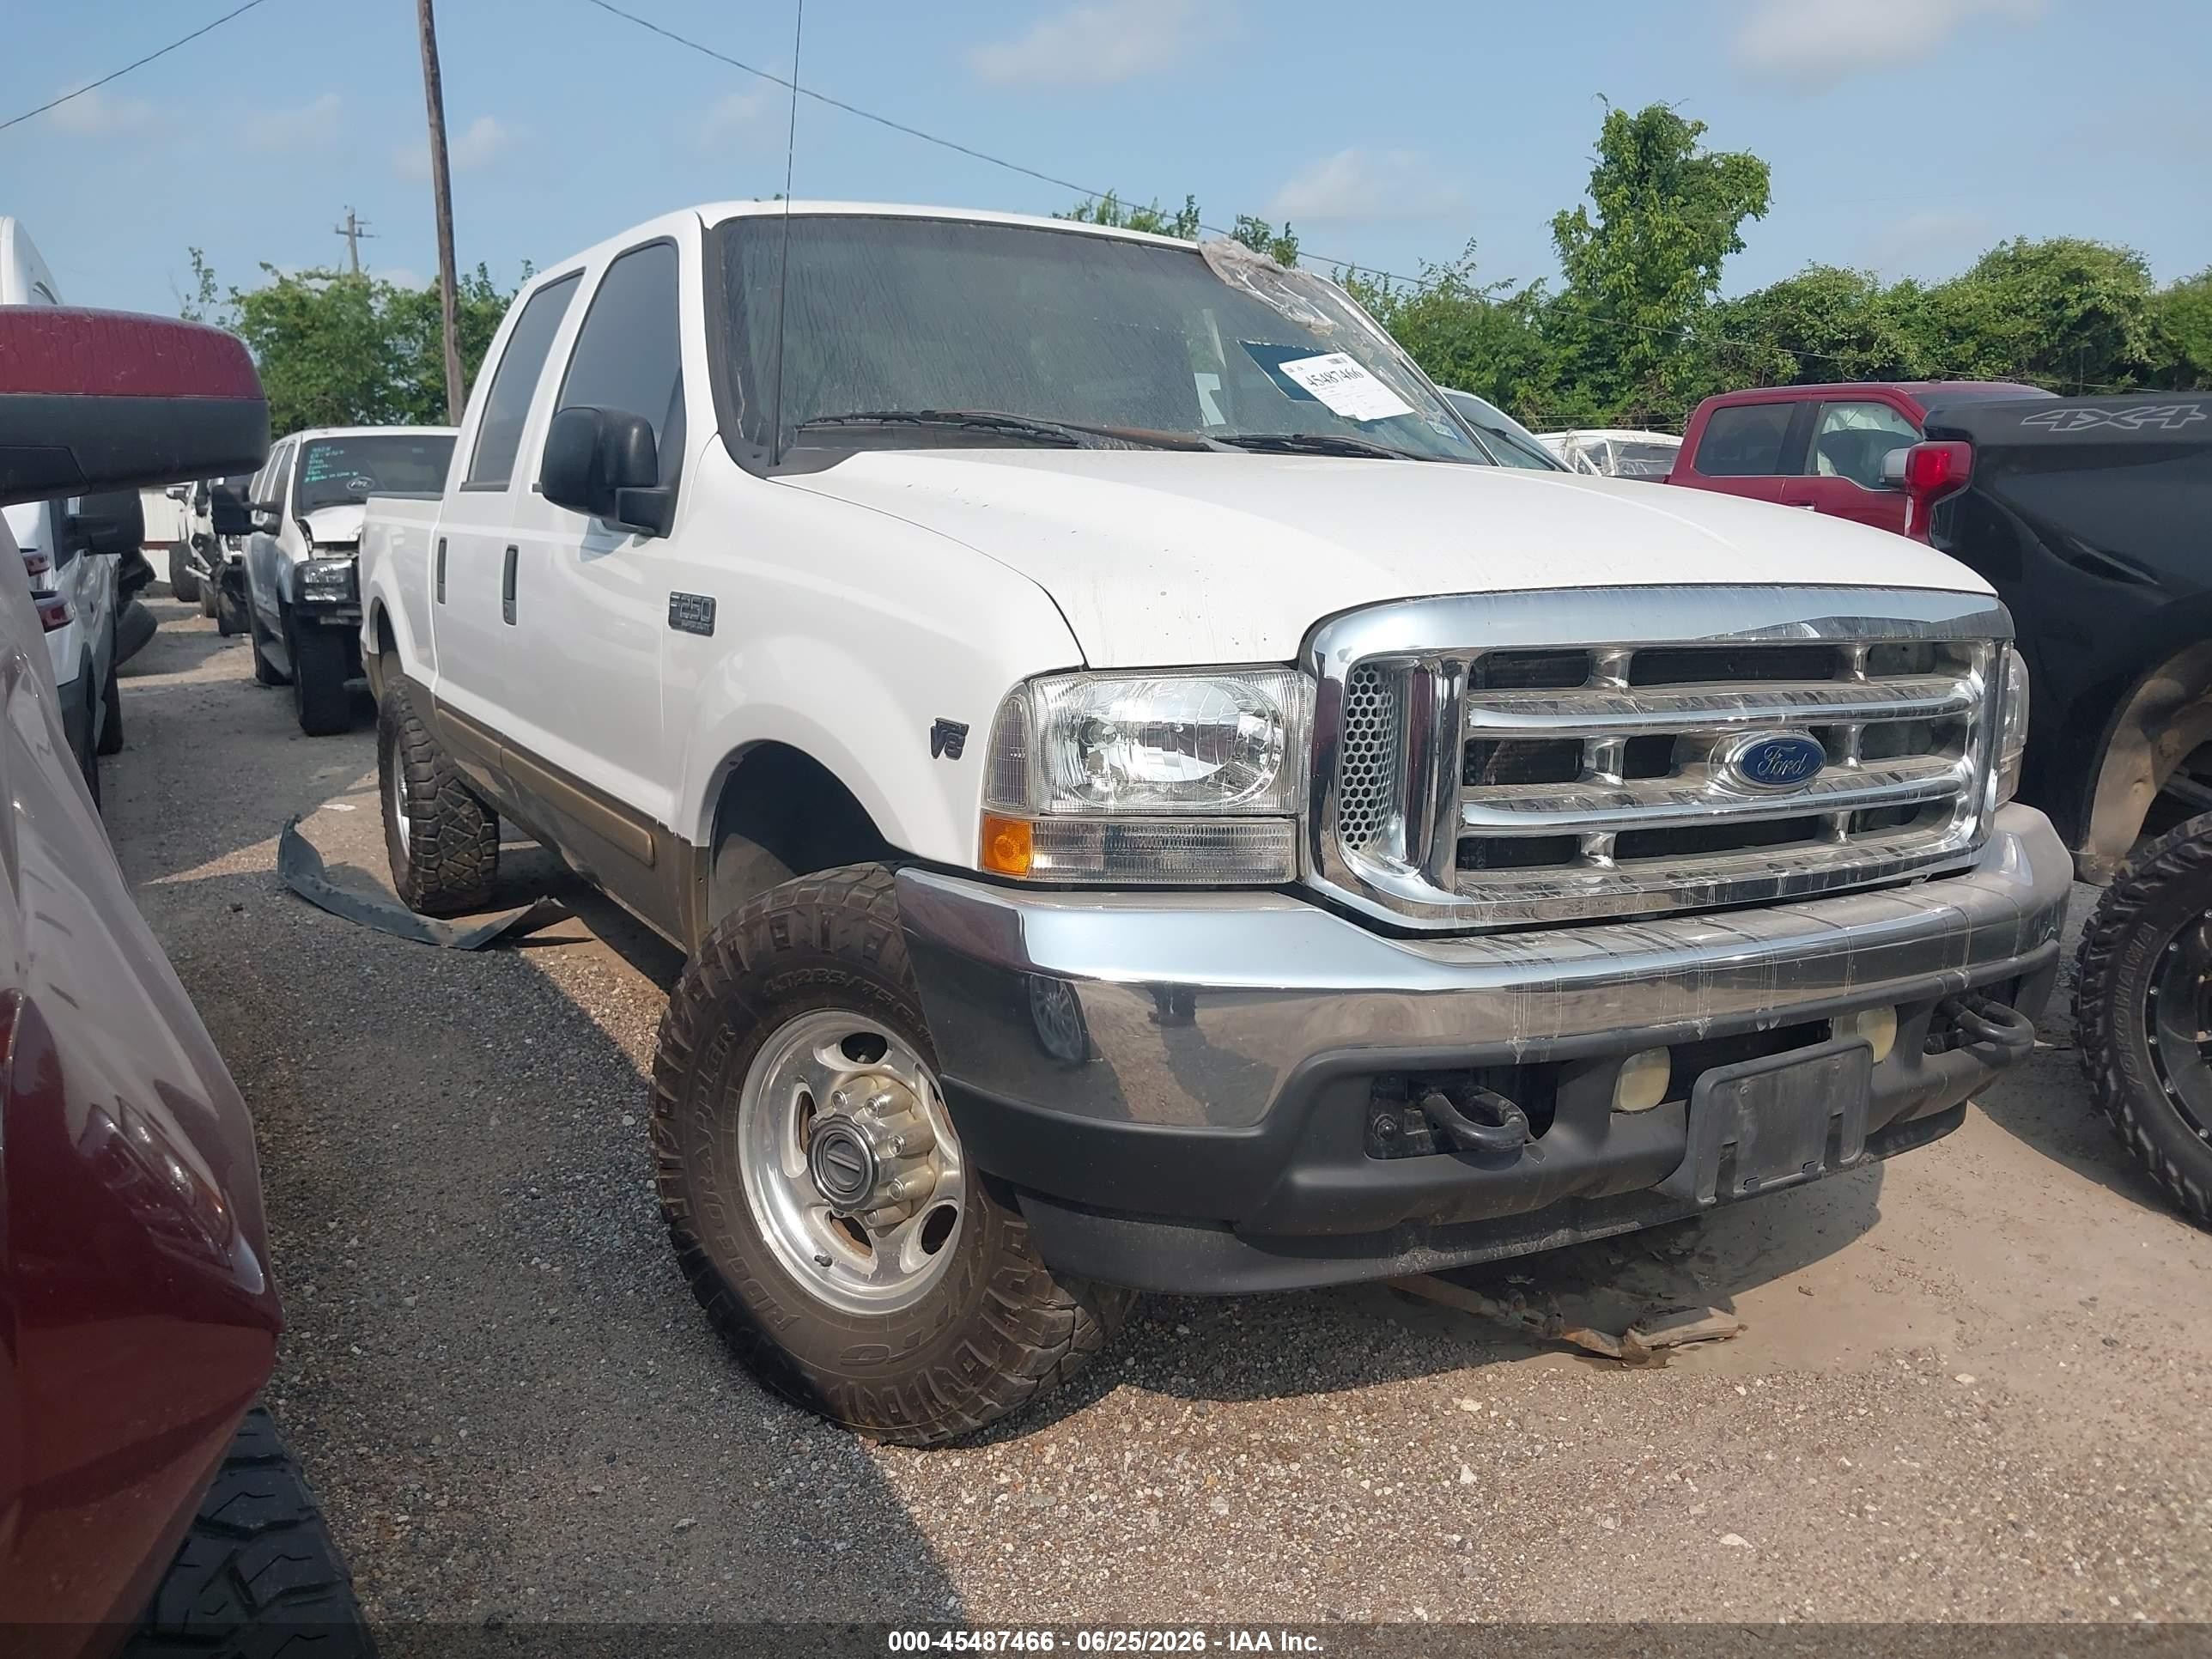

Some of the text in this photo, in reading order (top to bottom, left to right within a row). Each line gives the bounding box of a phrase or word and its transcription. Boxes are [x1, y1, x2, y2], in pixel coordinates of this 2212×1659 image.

[1305, 368, 1364, 387] 45487466
[1757, 744, 1808, 776] Ford
[2115, 921, 2159, 1092] YOKOHAMA
